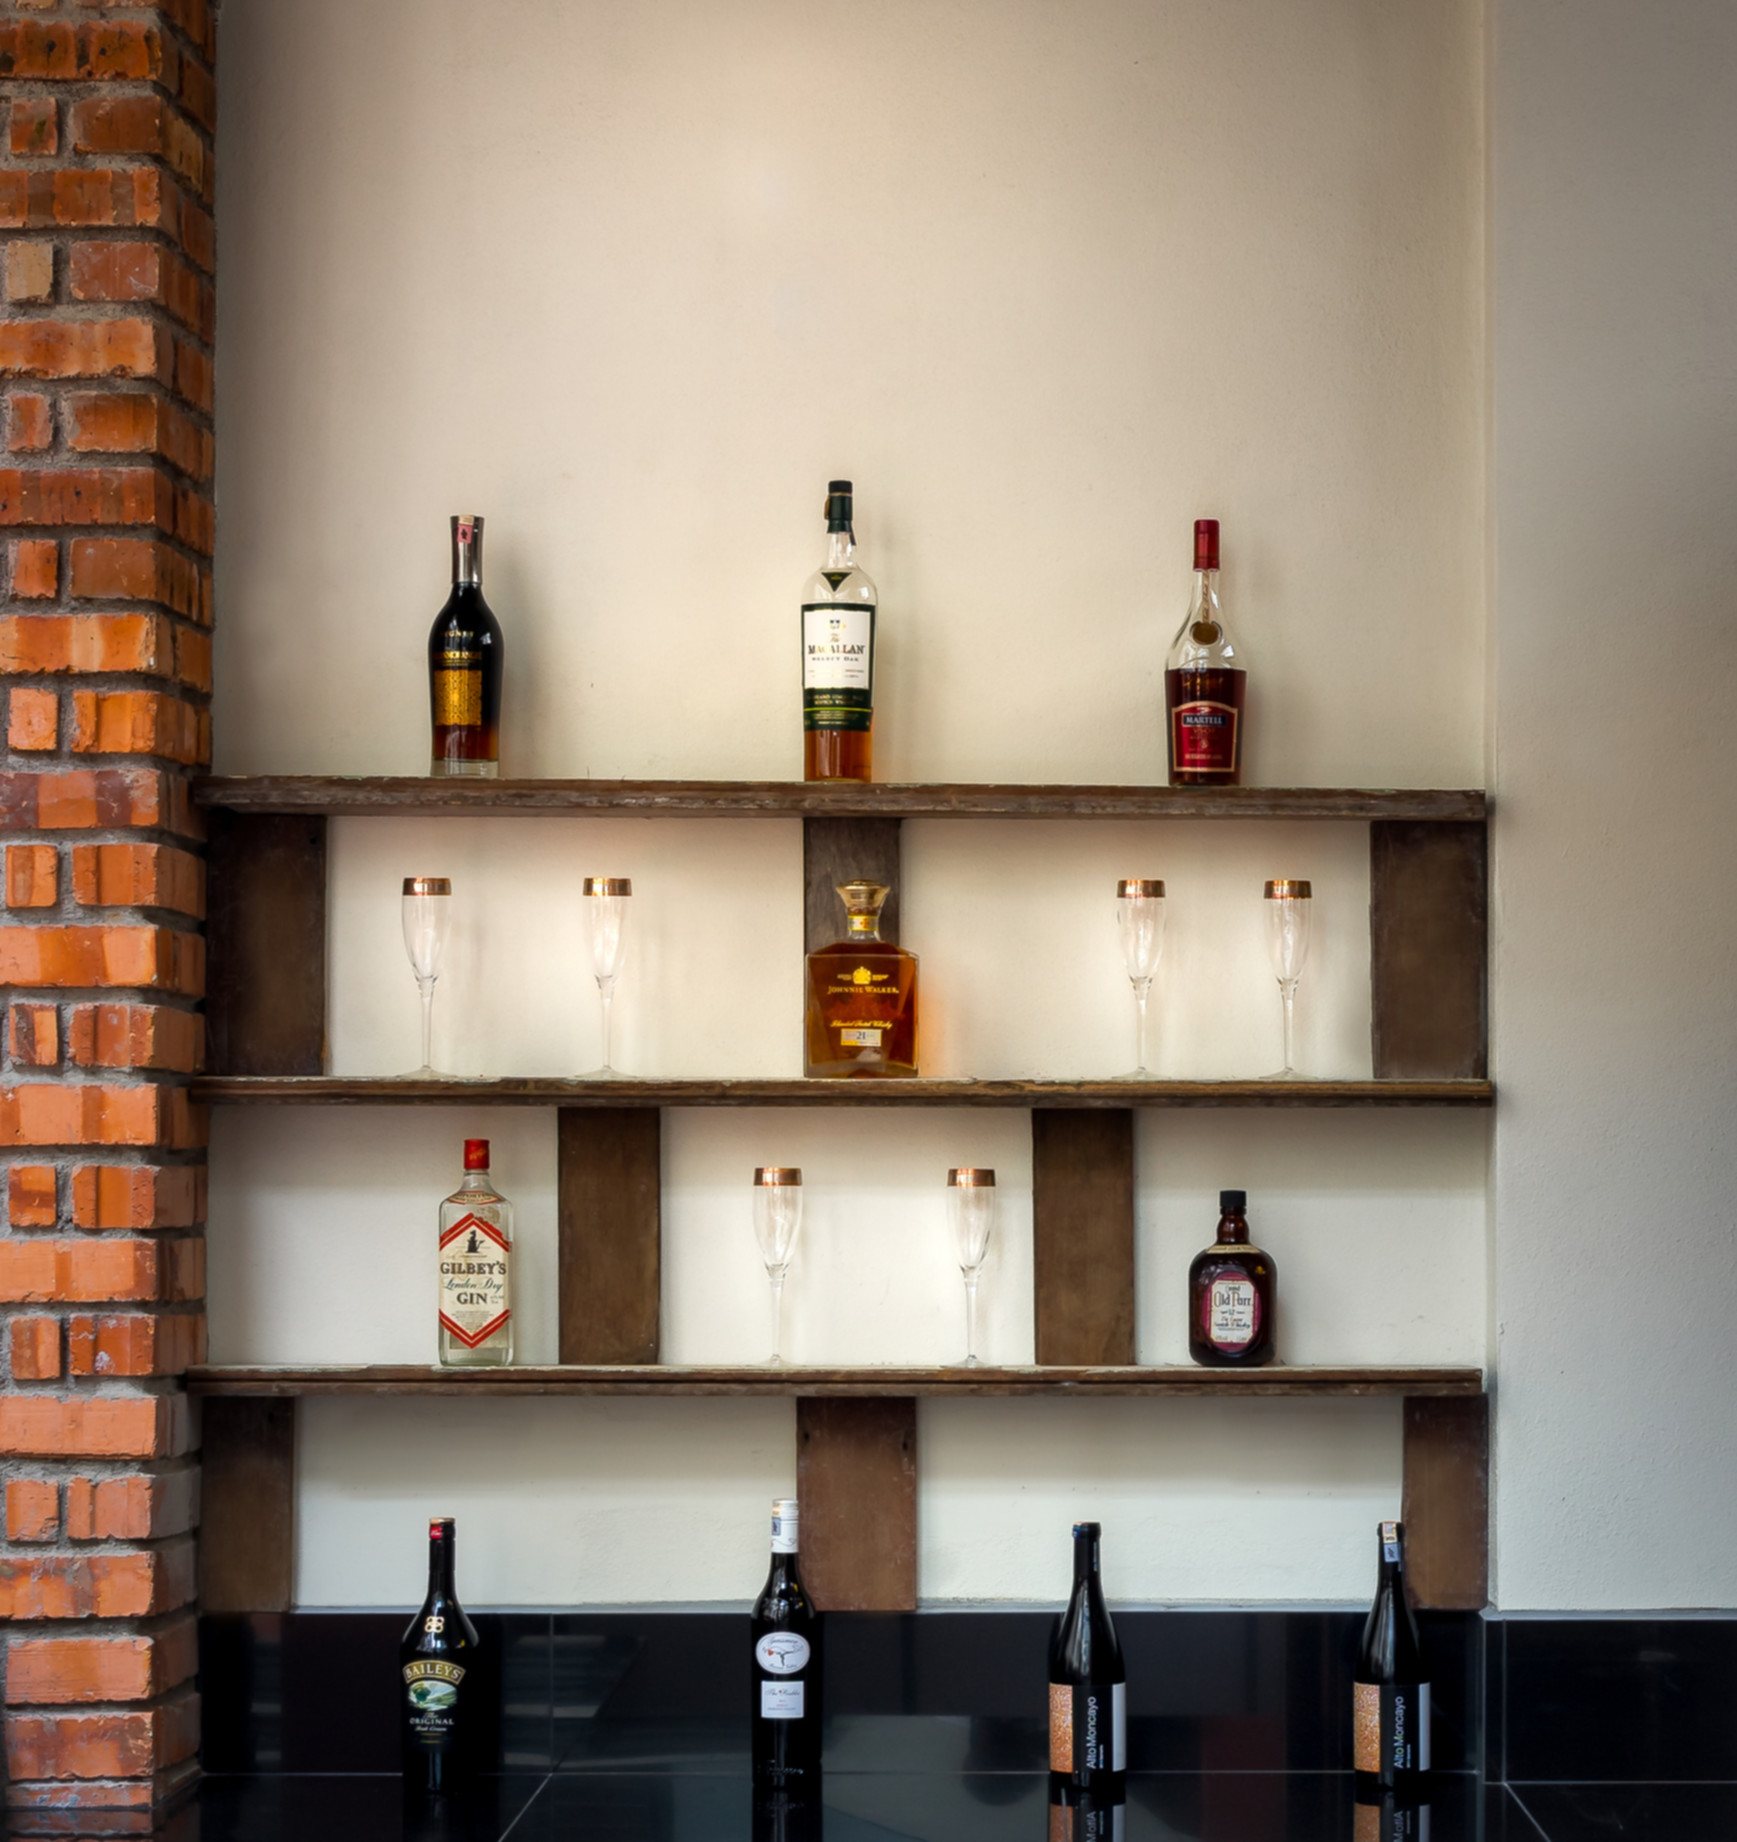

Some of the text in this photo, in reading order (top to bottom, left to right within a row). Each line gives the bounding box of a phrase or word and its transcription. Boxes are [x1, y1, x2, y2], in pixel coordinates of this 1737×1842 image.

[808, 644, 866, 655] MAALLAN
[1186, 716, 1222, 724] MARTELL
[827, 986, 863, 995] JOHNNIE
[856, 1031, 866, 1040] 21
[440, 1261, 507, 1275] GILBEY'S
[445, 1277, 504, 1293] London Dry
[456, 1292, 488, 1305] GIN
[1214, 1291, 1251, 1308] Old Parr
[405, 1663, 461, 1679] BAILEYS
[409, 1717, 454, 1725] ORIGINAL
[1086, 1696, 1098, 1769] Alto Moncayo
[1393, 1696, 1406, 1769] Alto Moncayo
